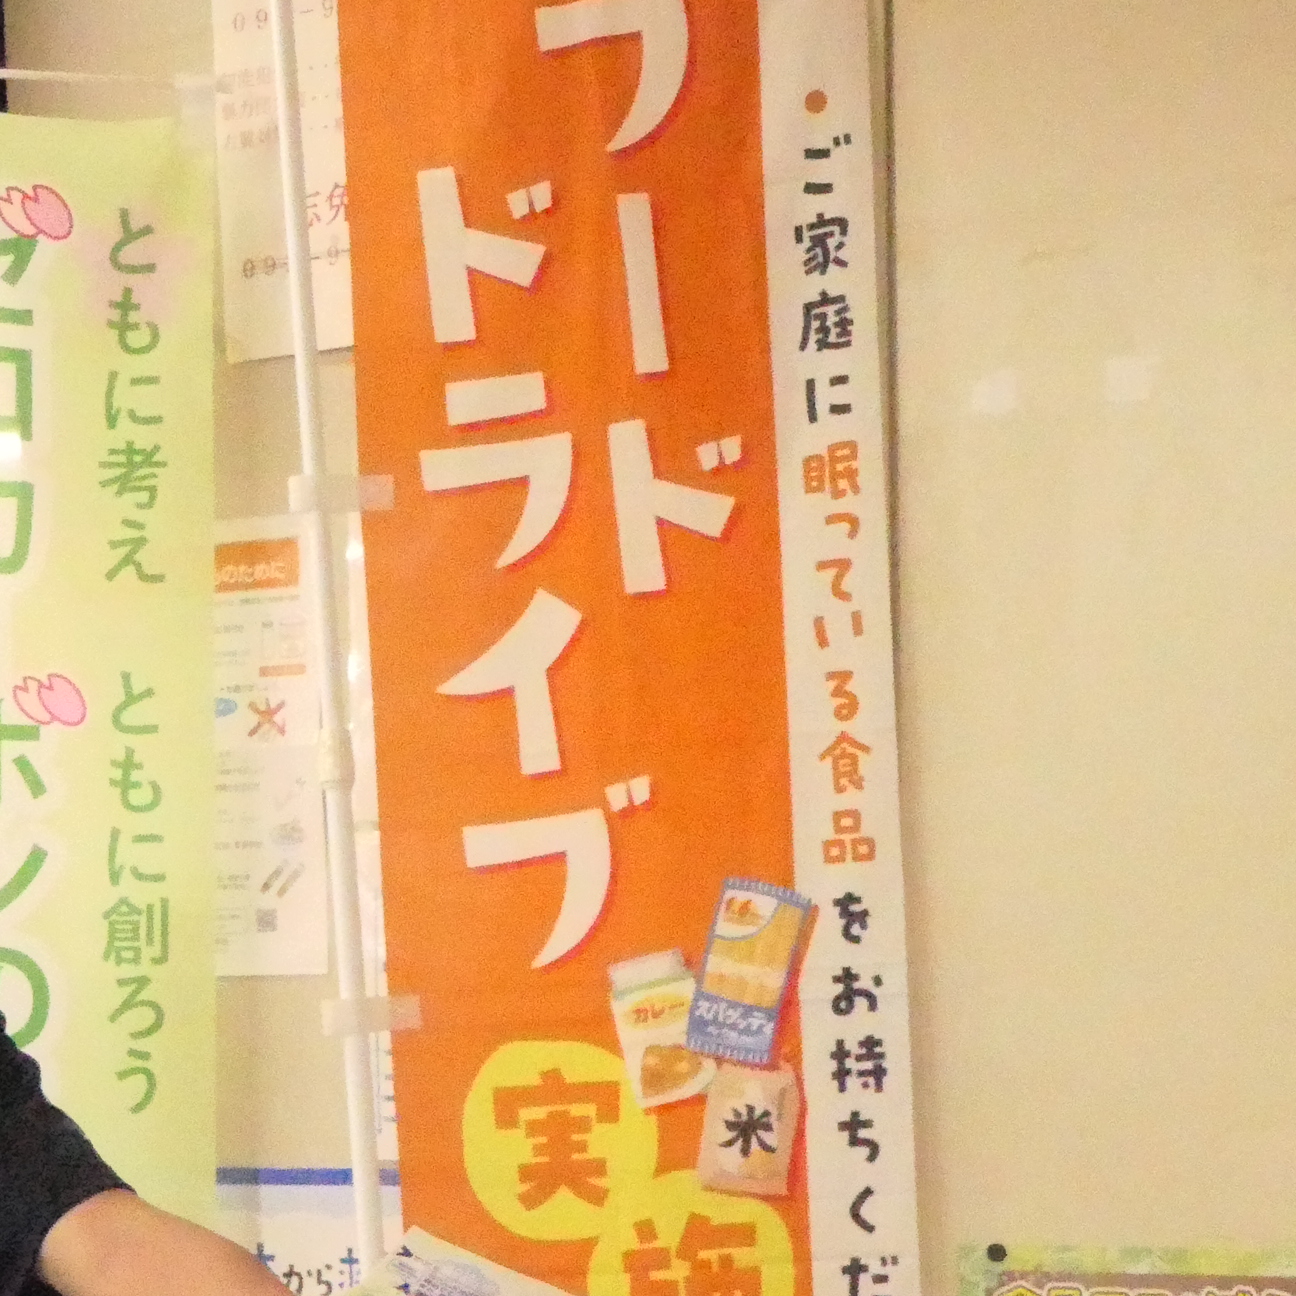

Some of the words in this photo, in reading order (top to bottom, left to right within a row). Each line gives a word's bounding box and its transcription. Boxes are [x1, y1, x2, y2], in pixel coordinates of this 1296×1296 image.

[97, 206, 169, 586] ともに考え
[416, 165, 652, 970] ドライブ
[101, 671, 171, 1116] ともに創ろう
[719, 1103, 778, 1158] 米
